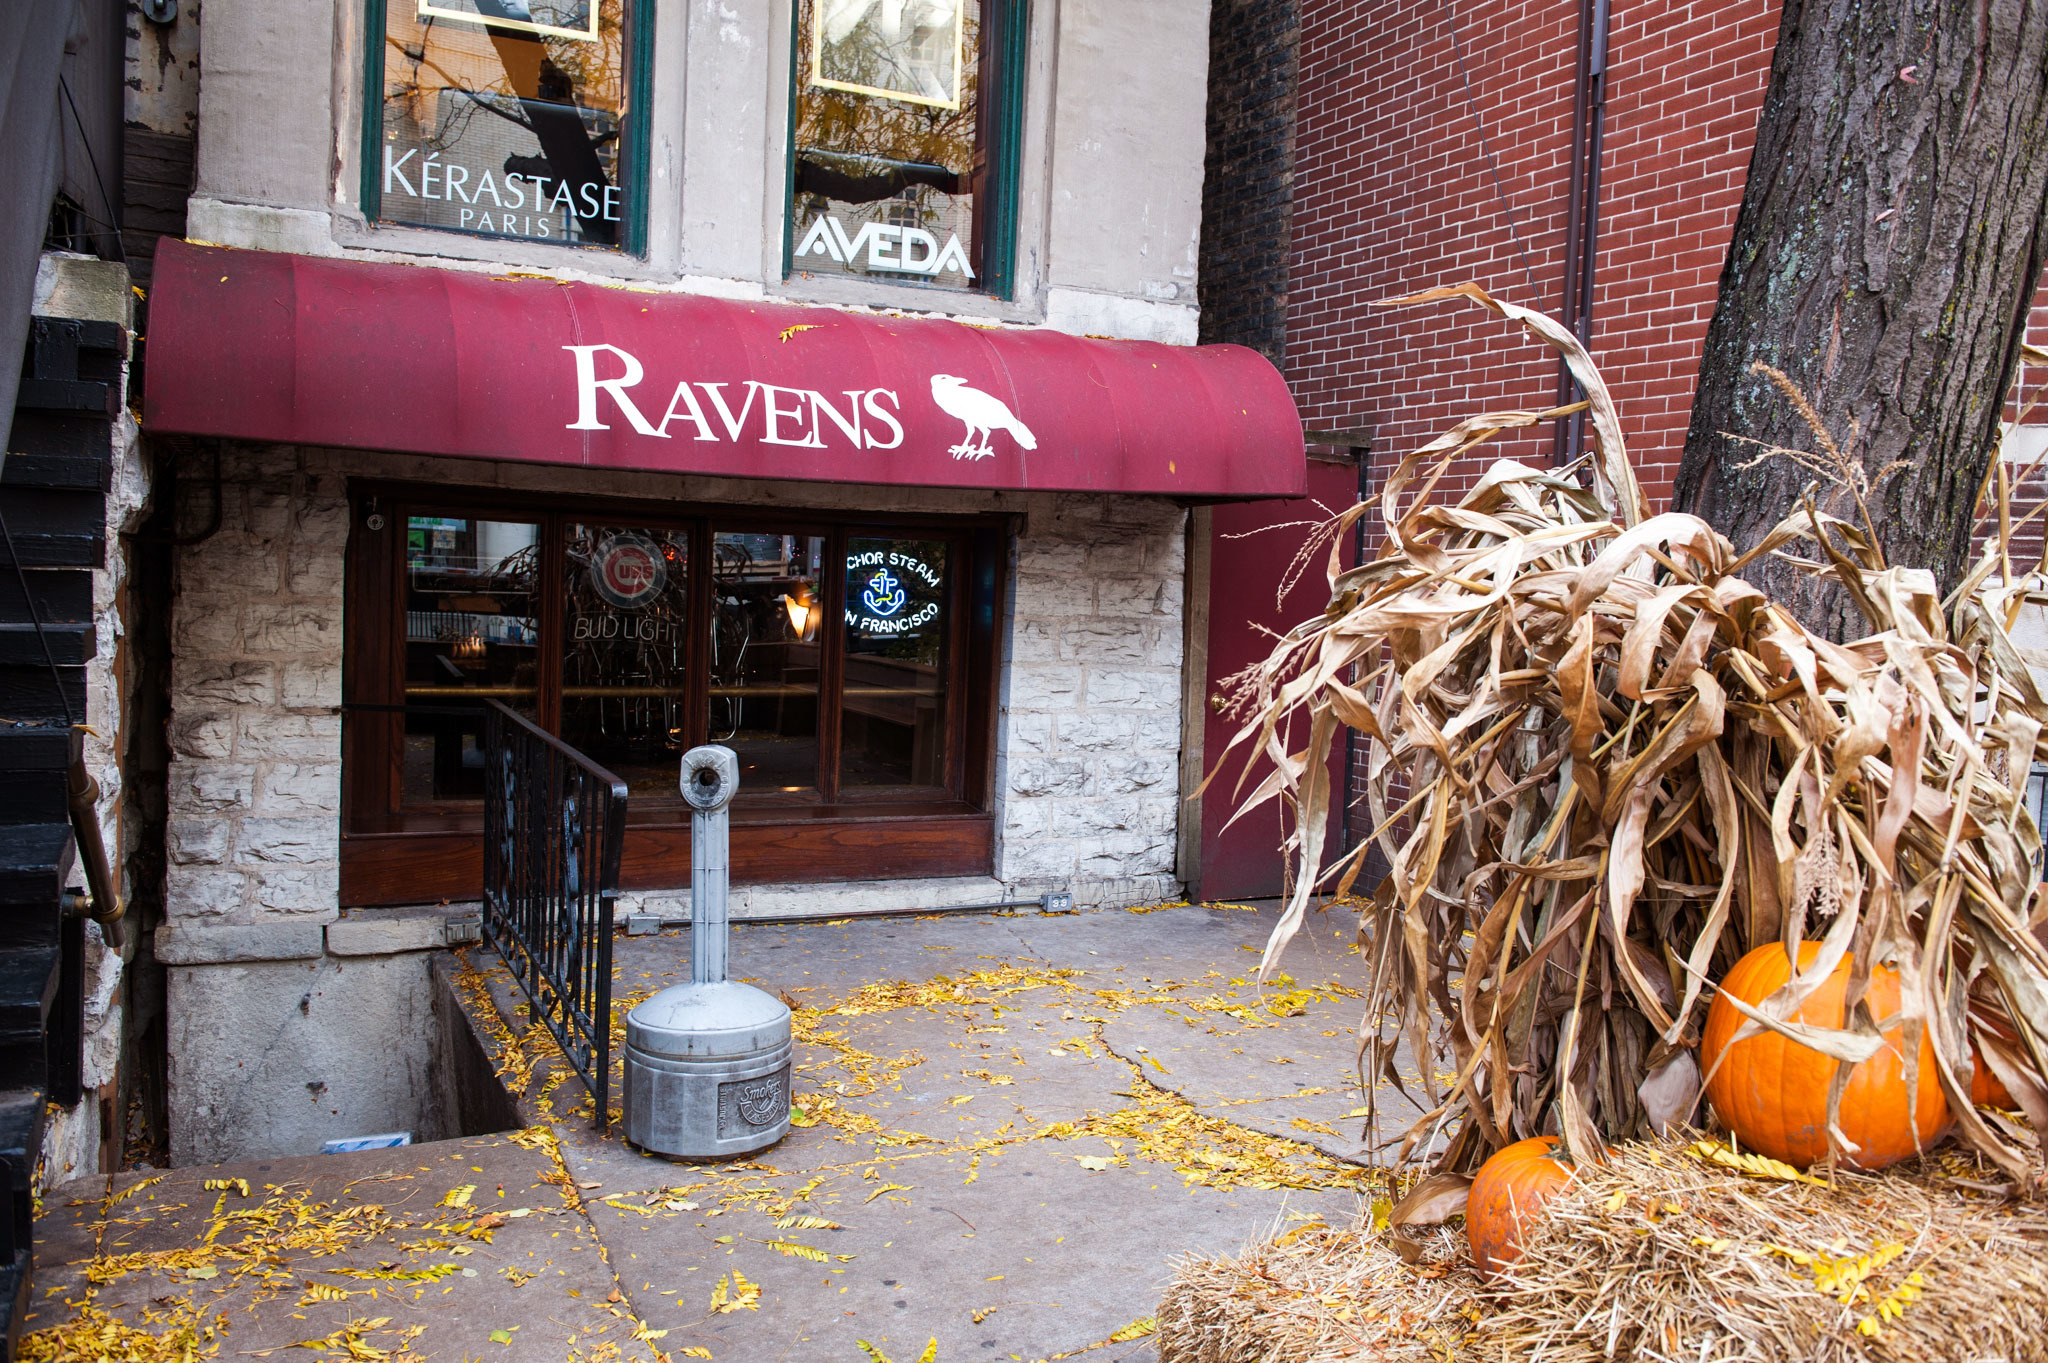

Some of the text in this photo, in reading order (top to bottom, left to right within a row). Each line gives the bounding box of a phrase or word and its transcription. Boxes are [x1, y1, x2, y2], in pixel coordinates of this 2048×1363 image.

[383, 145, 622, 222] KÉRASTASE
[460, 208, 550, 238] PARIS
[794, 213, 976, 279] AVEDA
[846, 551, 940, 588] CHOR STEAM
[574, 615, 680, 642] BUD LIGHT
[860, 603, 938, 633] FRANCISCO
